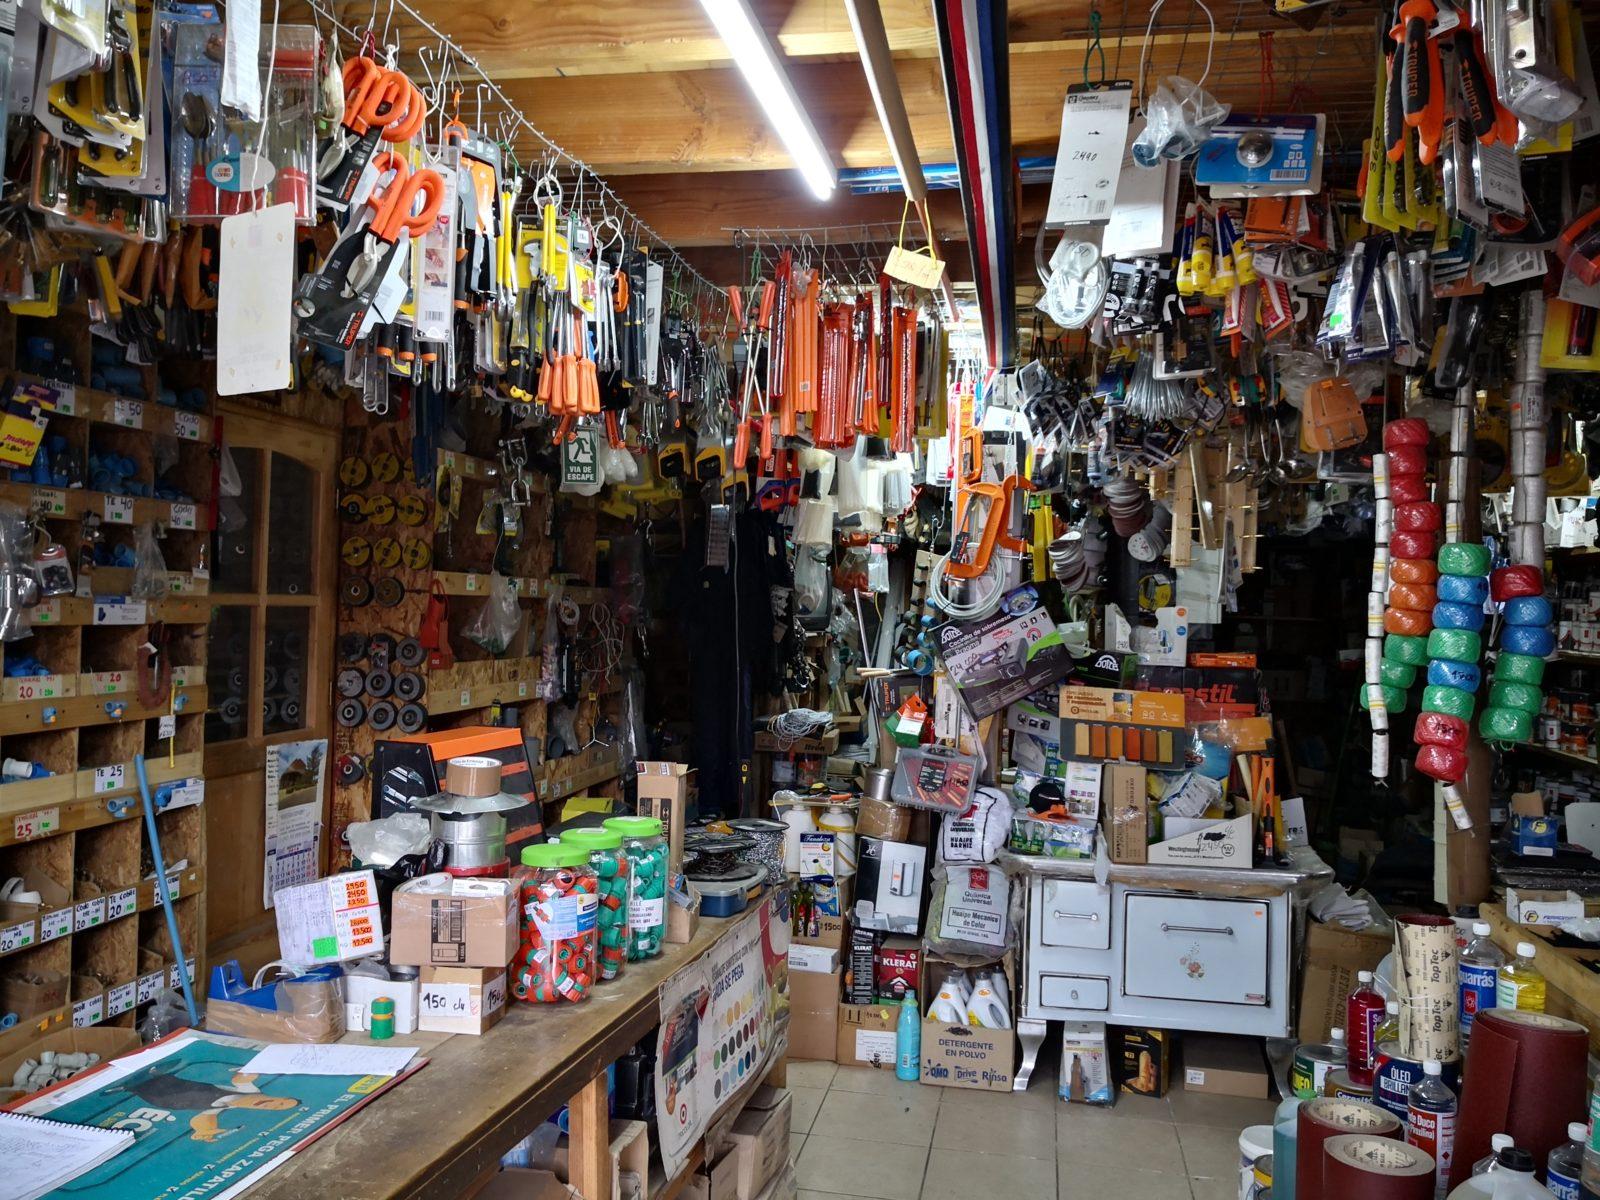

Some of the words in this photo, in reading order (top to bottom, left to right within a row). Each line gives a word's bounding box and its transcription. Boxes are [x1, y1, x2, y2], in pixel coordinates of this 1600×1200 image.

[1408, 52, 1418, 96] TRUPER
[1464, 72, 1482, 120] TRUPER
[344, 318, 361, 347] TRUPER
[130, 403, 142, 416] 50
[175, 424, 186, 436] 50
[106, 496, 115, 505] TE
[120, 497, 132, 510] 40
[982, 615, 1011, 632] sobremesa
[20, 686, 33, 698] 20
[97, 768, 104, 777] TE
[110, 765, 122, 776] 25
[17, 823, 32, 836] 25
[110, 905, 122, 919] 20
[76, 920, 85, 930] 20
[971, 920, 985, 929] Color
[42, 930, 52, 940] 20
[1, 940, 13, 951] 20
[882, 958, 918, 969] KLERAT
[1430, 949, 1440, 983] TopTec
[732, 962, 744, 985] PEGA
[172, 979, 180, 988] 20
[139, 991, 149, 1000] 20
[423, 991, 446, 1009] 150
[109, 1006, 118, 1017] 20
[1432, 999, 1443, 1033] TopTec
[938, 1039, 993, 1050] DETERGENTE
[959, 1051, 986, 1059] POLVO
[930, 1067, 949, 1078] OMO
[957, 1069, 977, 1078] Drive
[982, 1070, 1007, 1082] Rinso
[1390, 1066, 1411, 1083] ÓLEO
[1383, 1079, 1410, 1095] BRILLAN
[334, 1094, 355, 1103] EL
[287, 1103, 338, 1134] PRIMER
[1417, 1115, 1435, 1128] Duco
[248, 1135, 290, 1158] PEGA
